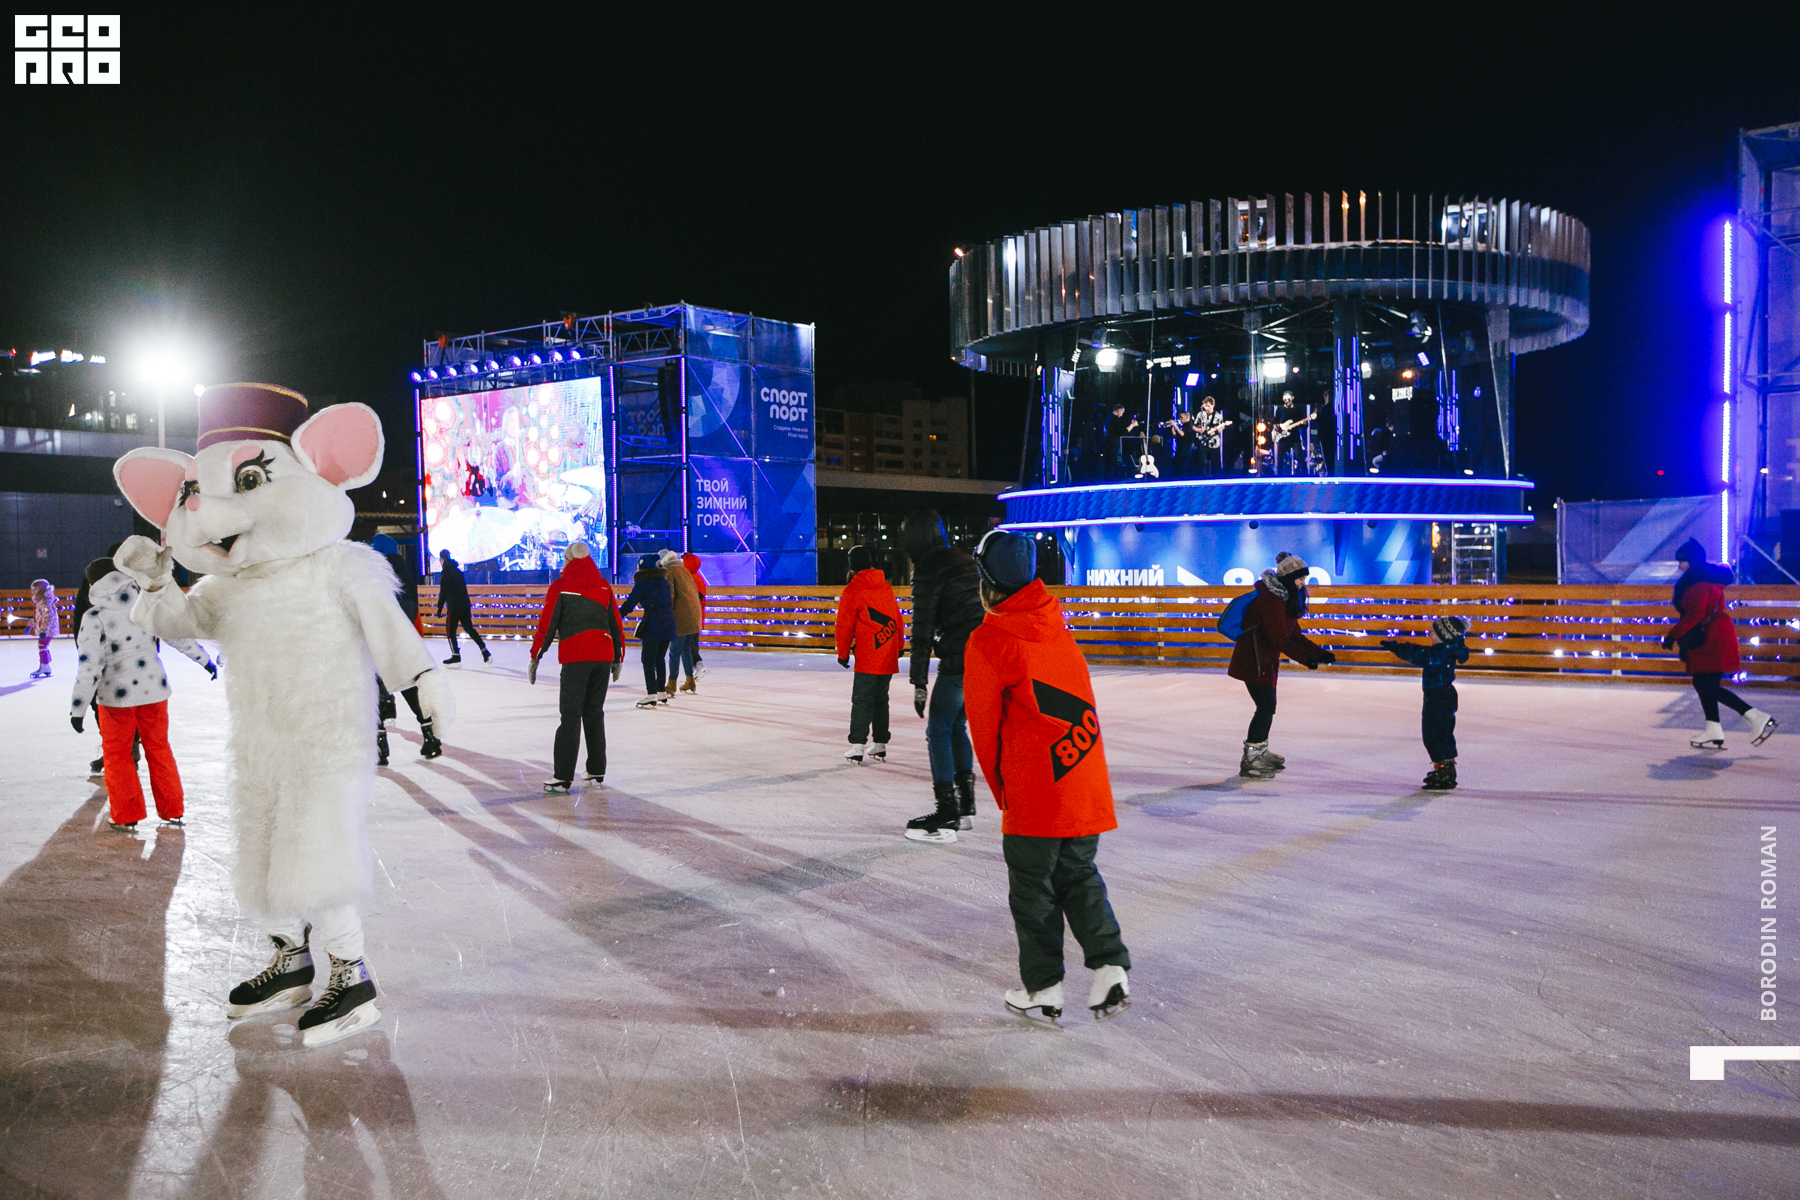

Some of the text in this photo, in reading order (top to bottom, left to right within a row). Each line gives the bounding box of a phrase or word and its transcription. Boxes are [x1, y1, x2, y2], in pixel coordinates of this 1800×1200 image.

[696, 477, 729, 493] ТВОЙ
[696, 495, 747, 510] ЗИМНИЙ
[696, 513, 738, 528] ГОРОД
[1086, 564, 1165, 587] НИЖНИЙ
[876, 620, 896, 644] 800
[1054, 709, 1099, 767] 800
